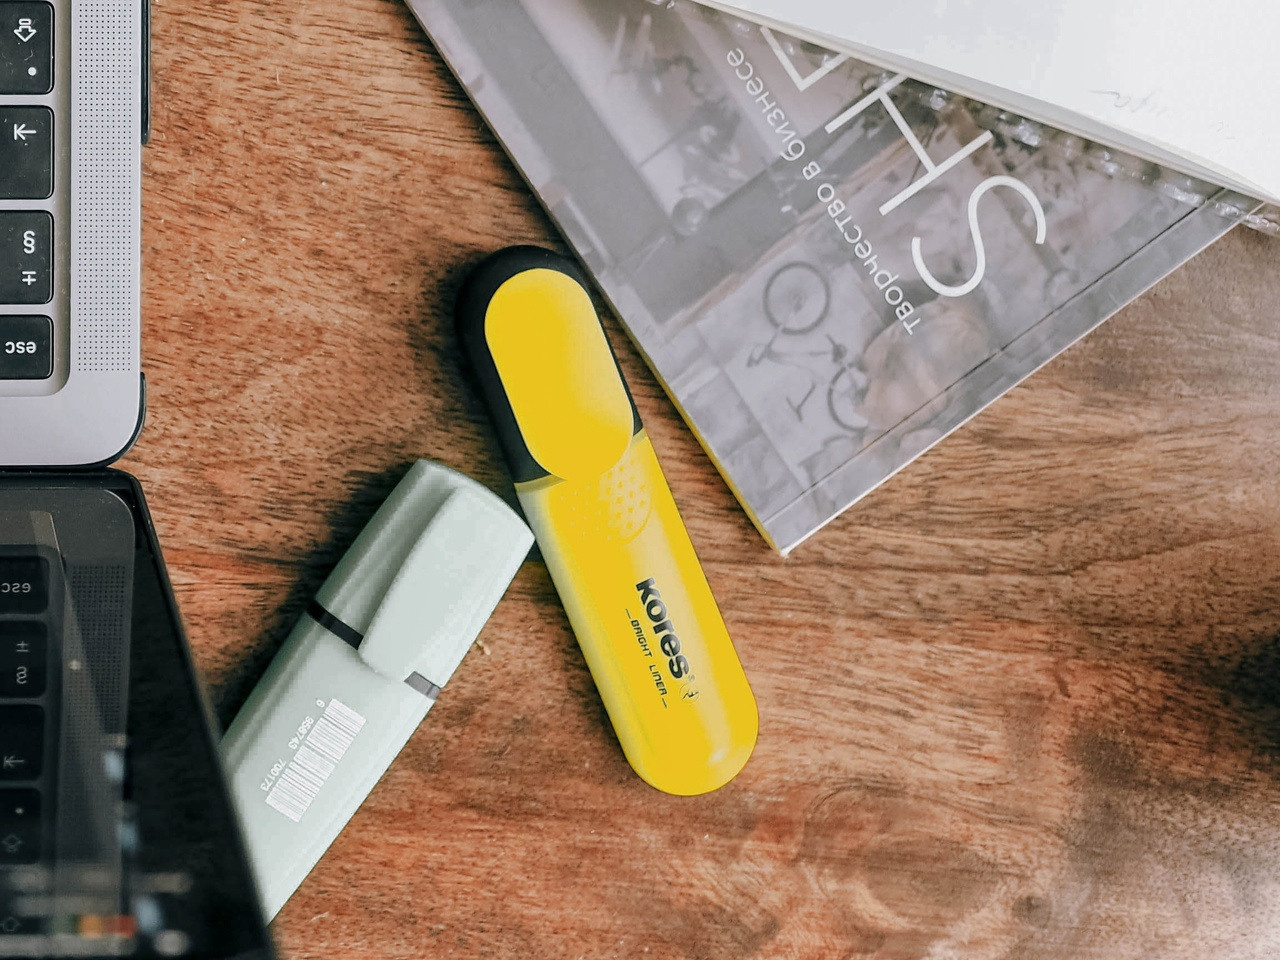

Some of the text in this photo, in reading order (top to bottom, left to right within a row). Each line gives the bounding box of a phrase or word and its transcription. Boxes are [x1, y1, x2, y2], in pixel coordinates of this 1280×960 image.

[726, 48, 806, 162] бизнесе
[4, 341, 37, 354] esc
[630, 619, 652, 657] BRIGHT
[260, 758, 286, 792] 700173
